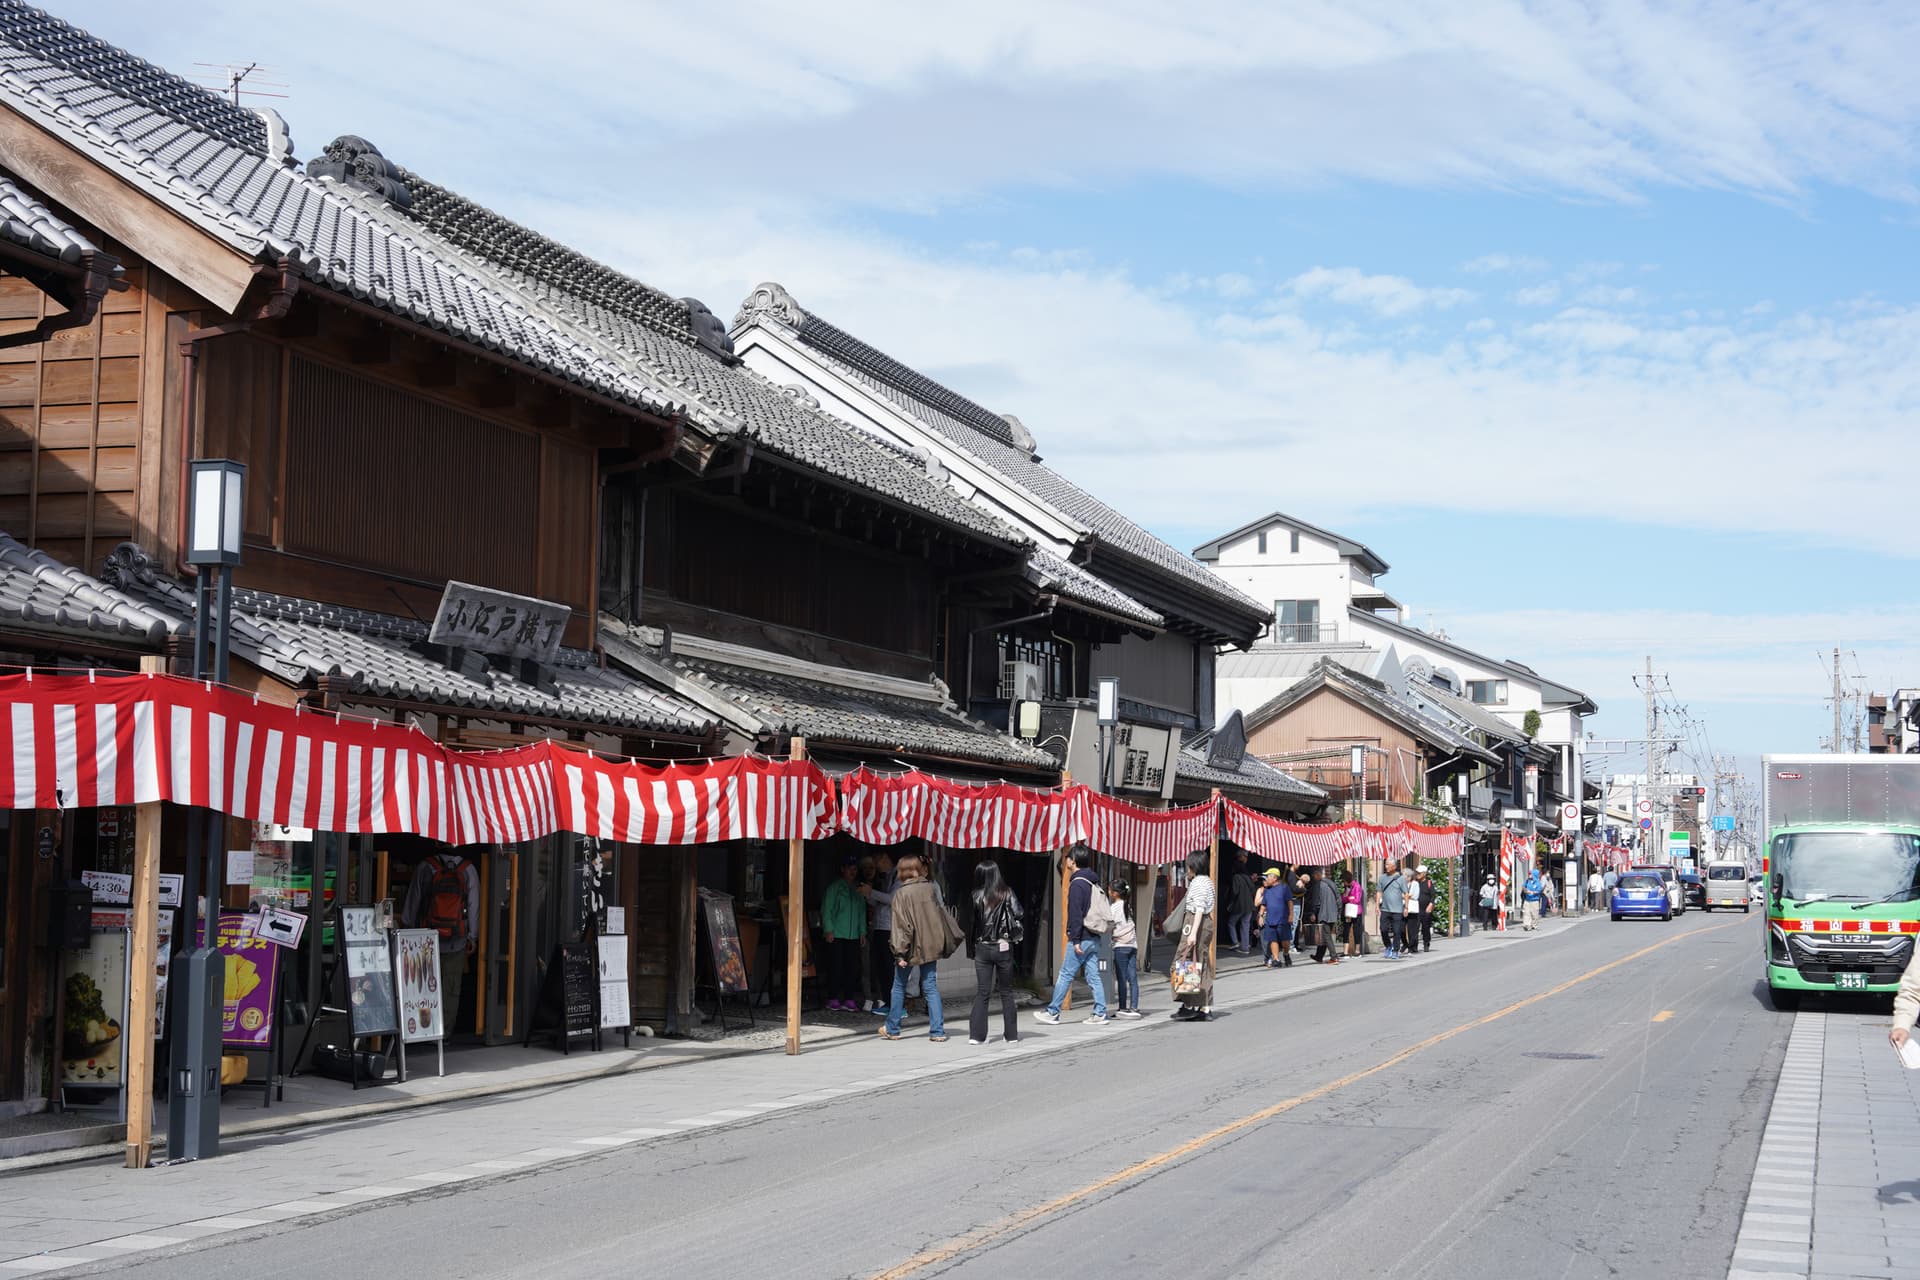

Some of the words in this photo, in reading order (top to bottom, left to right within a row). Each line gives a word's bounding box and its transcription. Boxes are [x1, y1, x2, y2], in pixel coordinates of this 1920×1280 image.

[446, 598, 562, 649] 小江戸横丁
[86, 881, 121, 892] 14:30
[217, 936, 267, 949] チップス
[1831, 934, 1871, 943] ISUZU
